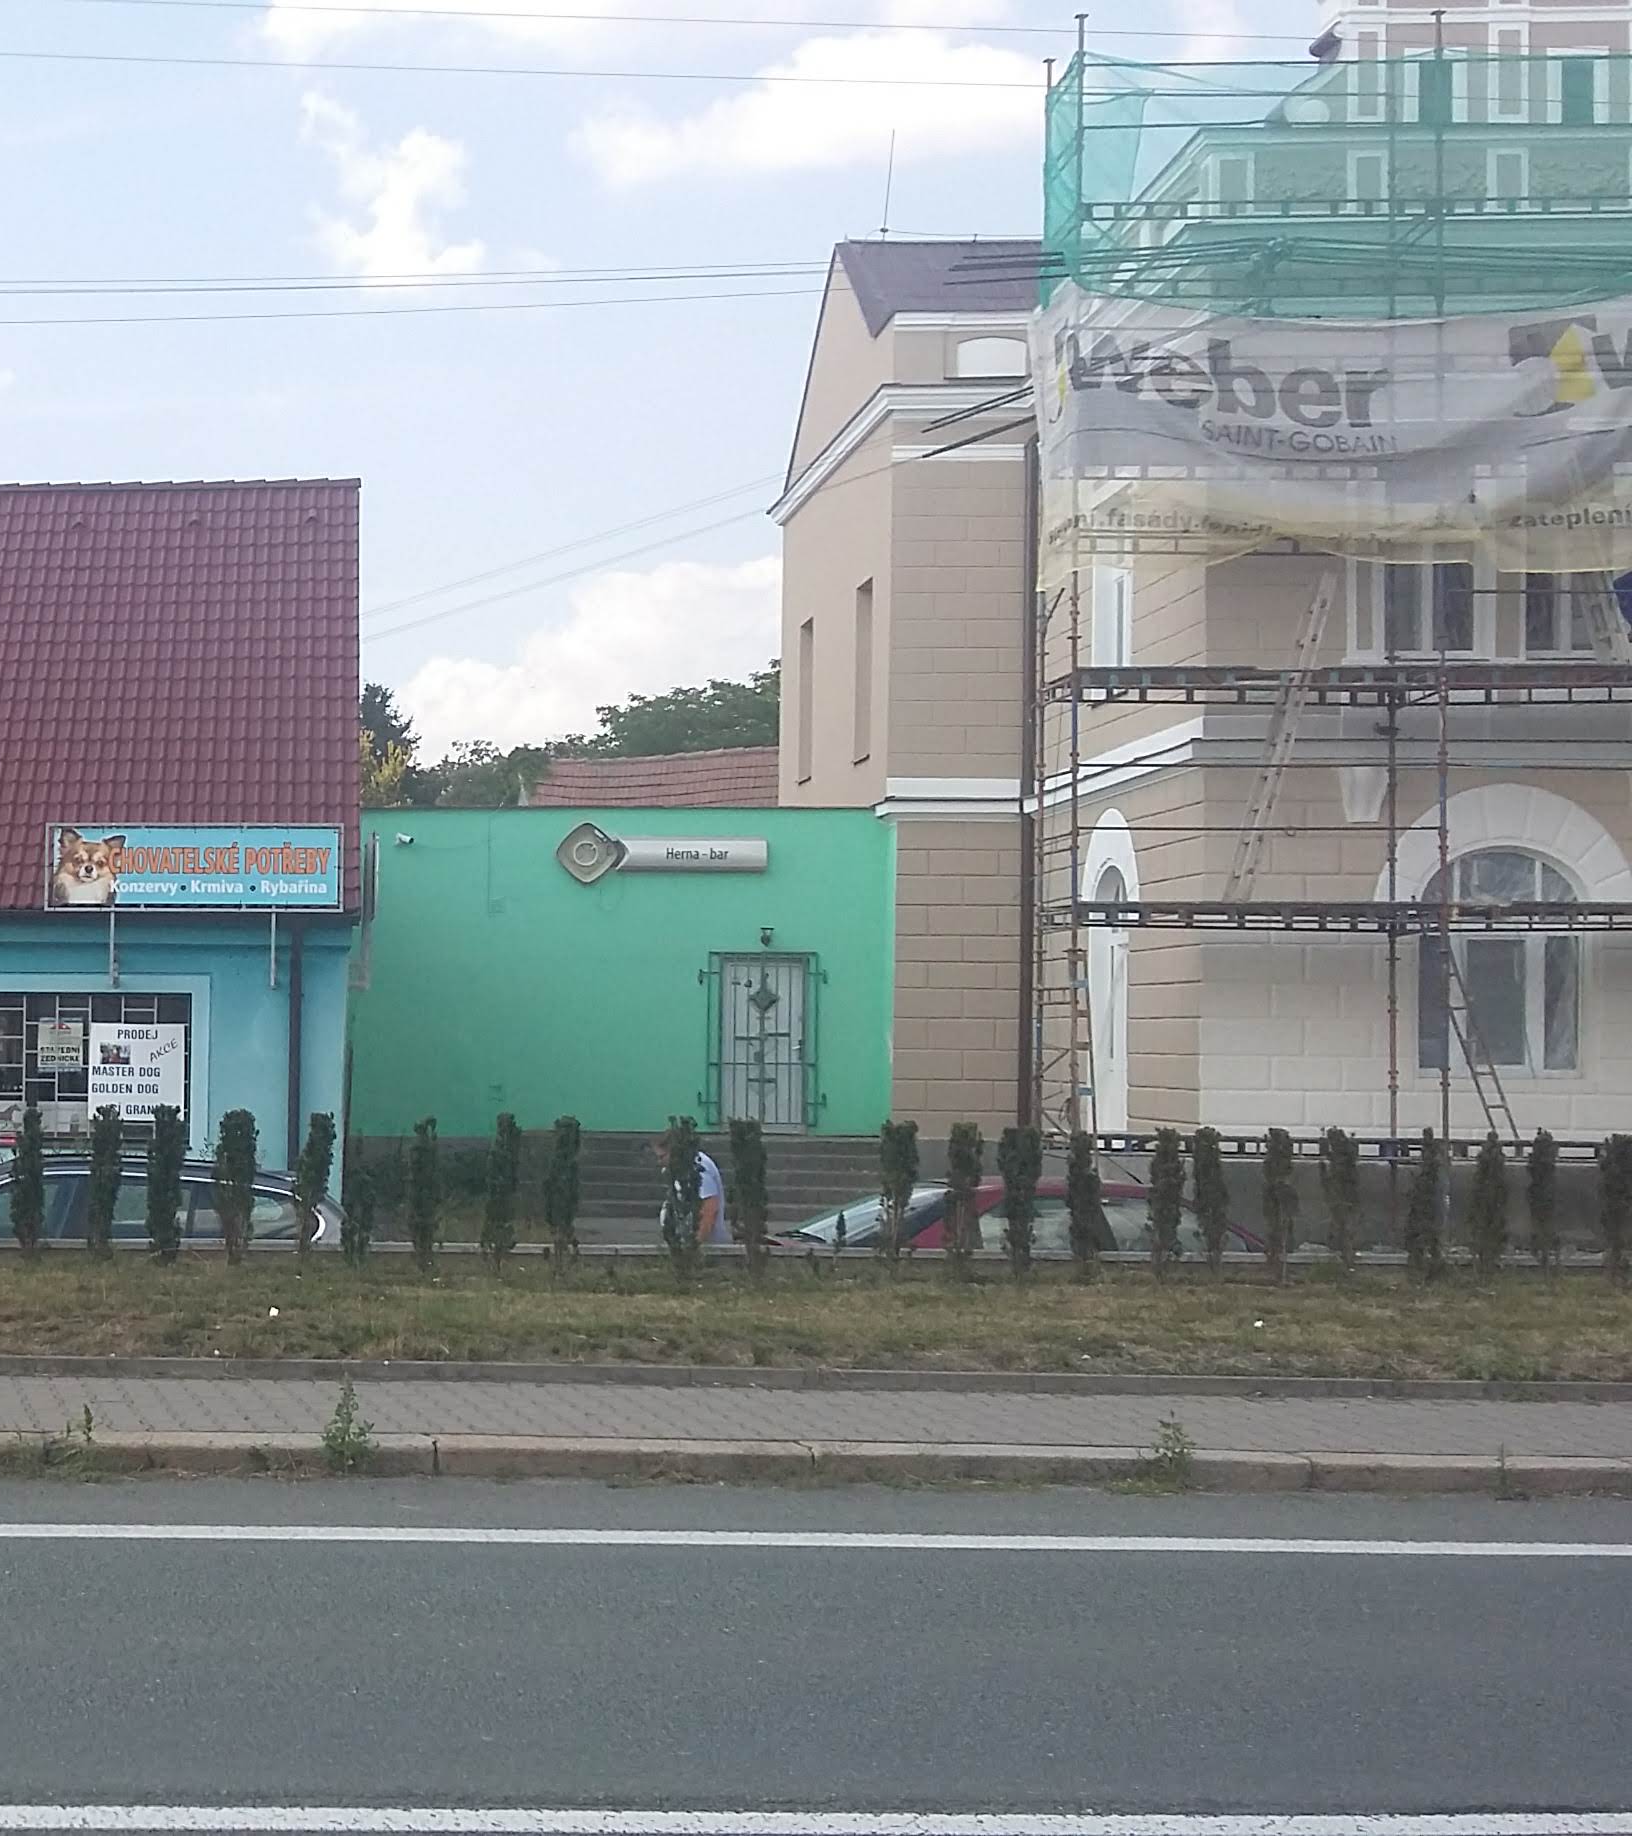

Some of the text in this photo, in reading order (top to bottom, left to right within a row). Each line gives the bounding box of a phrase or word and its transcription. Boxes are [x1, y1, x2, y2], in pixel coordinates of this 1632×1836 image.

[1201, 419, 1399, 453] SAINT-GOBAIN
[108, 841, 332, 875] CHOVATELSKÉ POTŘEBY
[666, 848, 699, 859] Herna
[710, 848, 729, 859] bar
[110, 879, 178, 896] Konzervy
[190, 879, 244, 894] Krmiva
[117, 1028, 159, 1040] PRODEJ
[150, 1038, 179, 1063] AKCE
[92, 1066, 161, 1078] MASTER DOG
[91, 1083, 159, 1094] GOLDEN DOG
